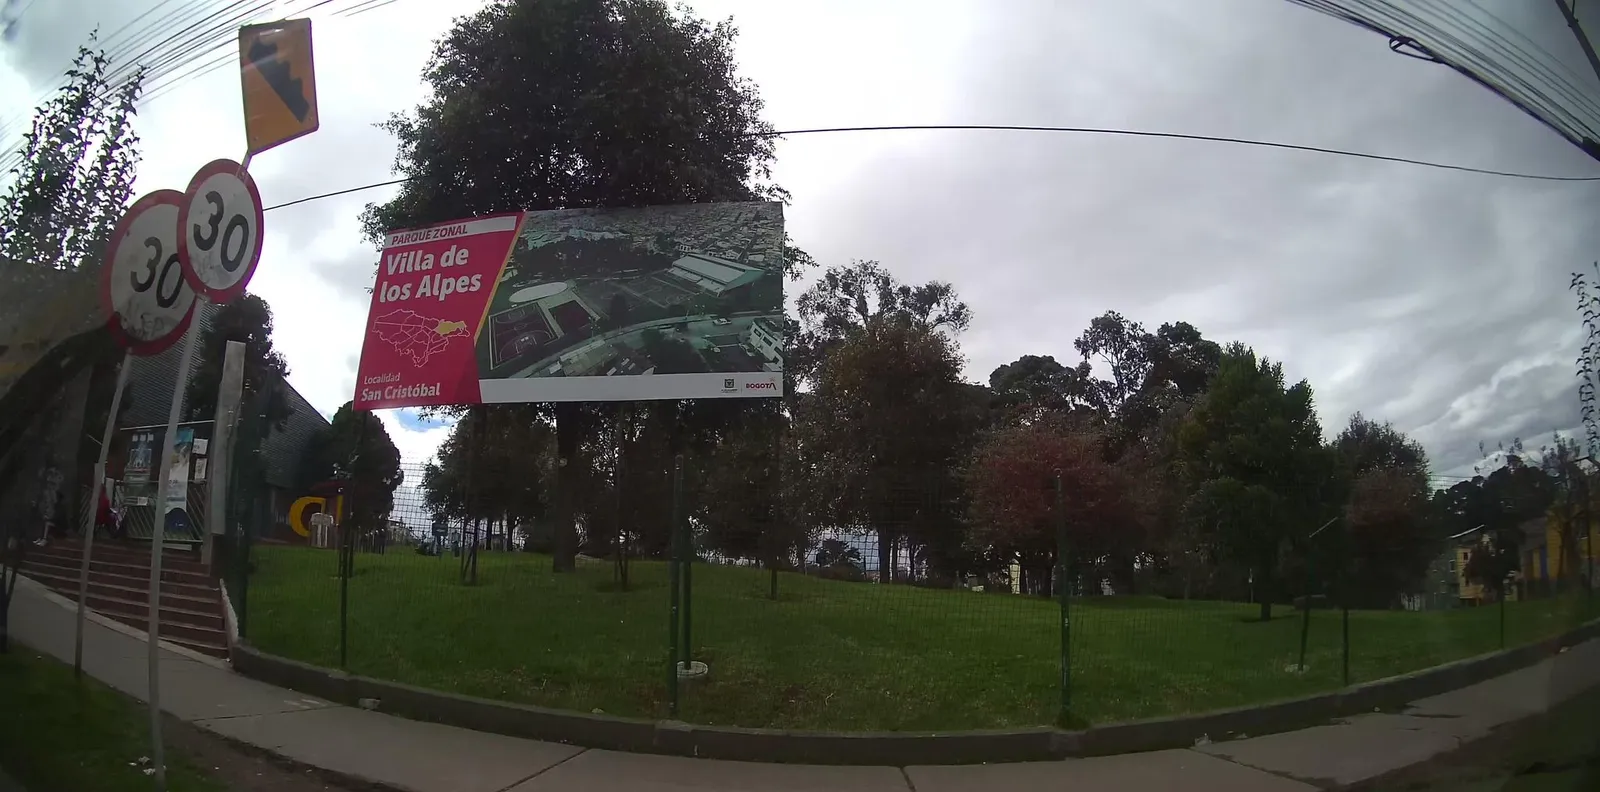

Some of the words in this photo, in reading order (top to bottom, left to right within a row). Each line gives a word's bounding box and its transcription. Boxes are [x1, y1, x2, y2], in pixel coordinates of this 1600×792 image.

[193, 190, 250, 273] 30
[391, 231, 432, 246] PARQUE
[433, 224, 468, 239] ZONAL
[130, 236, 185, 309] 30
[387, 250, 434, 276] Villa
[440, 244, 469, 267] de
[379, 281, 413, 303] los
[415, 273, 482, 301] Alpes
[361, 388, 381, 402] San
[384, 382, 441, 400] Cristóbal
[364, 372, 401, 385] Localidad
